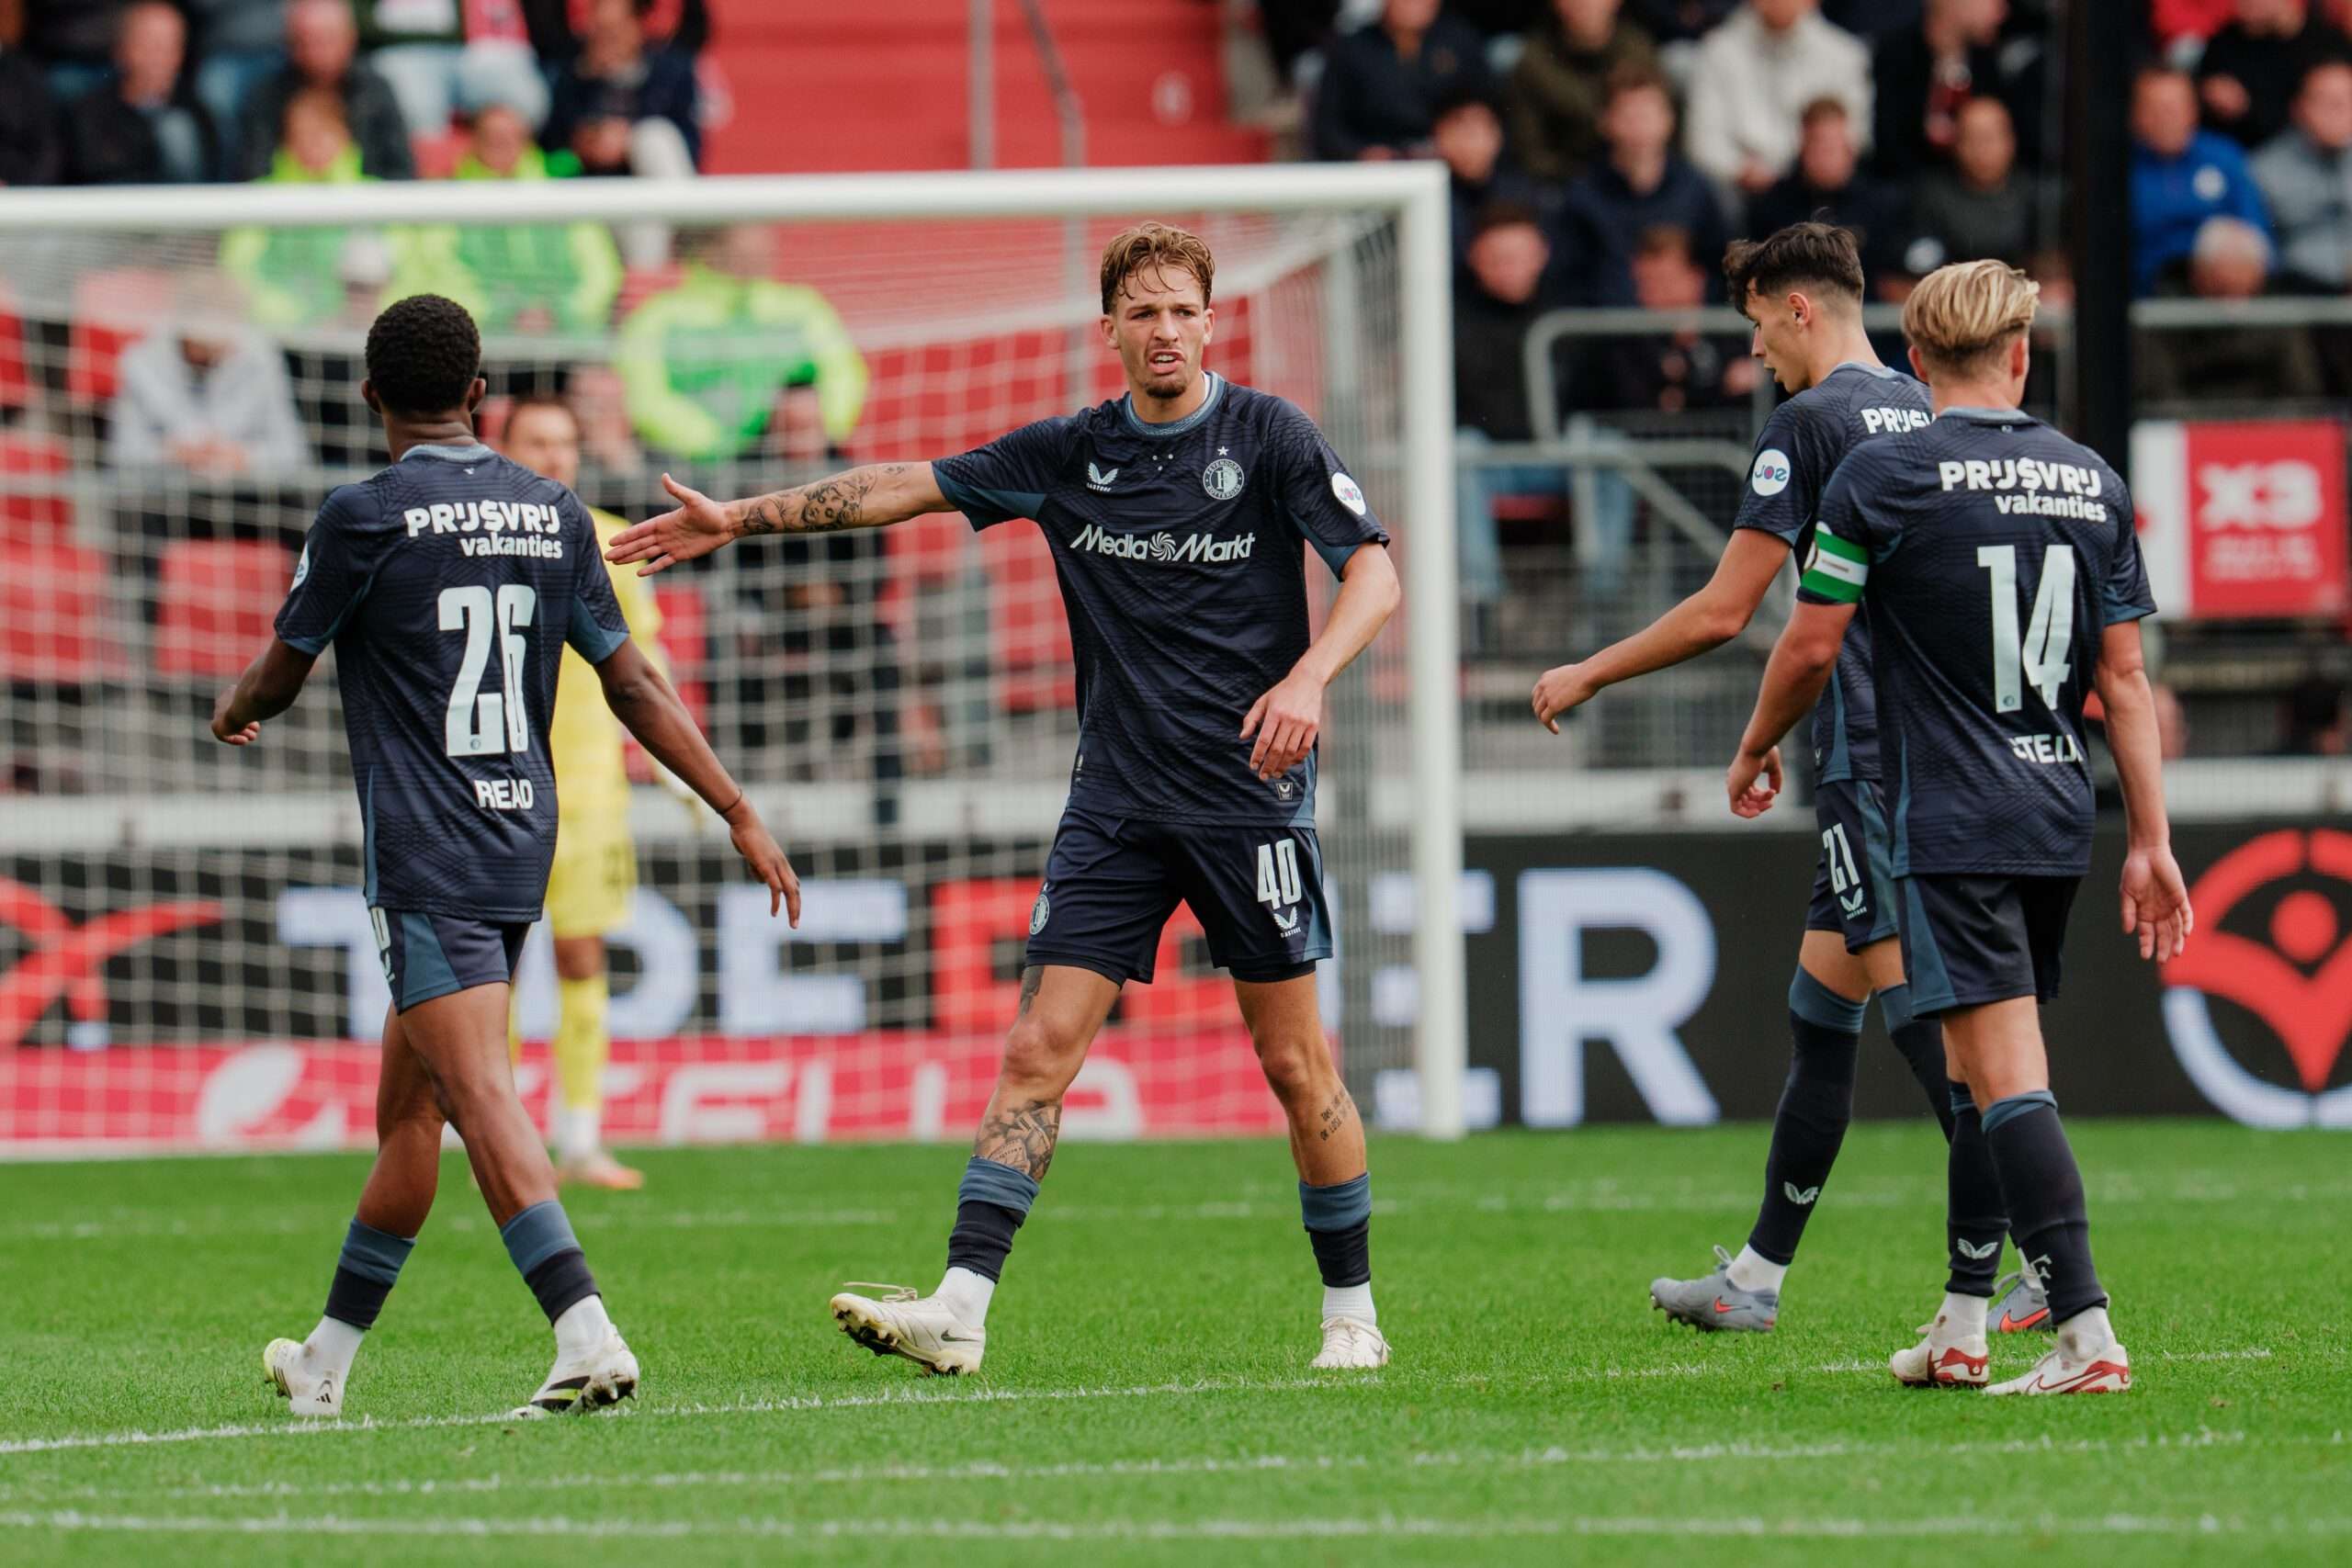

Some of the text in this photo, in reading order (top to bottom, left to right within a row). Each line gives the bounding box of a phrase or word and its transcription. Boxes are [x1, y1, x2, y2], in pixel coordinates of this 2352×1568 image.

[1939, 457, 2102, 498] PRIJSVRIJ
[403, 499, 560, 537] PRIJSVRIJ
[1995, 490, 2107, 523] vakanties
[460, 532, 563, 559] vakanties
[1977, 545, 2075, 714] 14
[438, 584, 537, 757] 26
[1257, 838, 1302, 910] 40
[1822, 823, 1860, 895] 21
